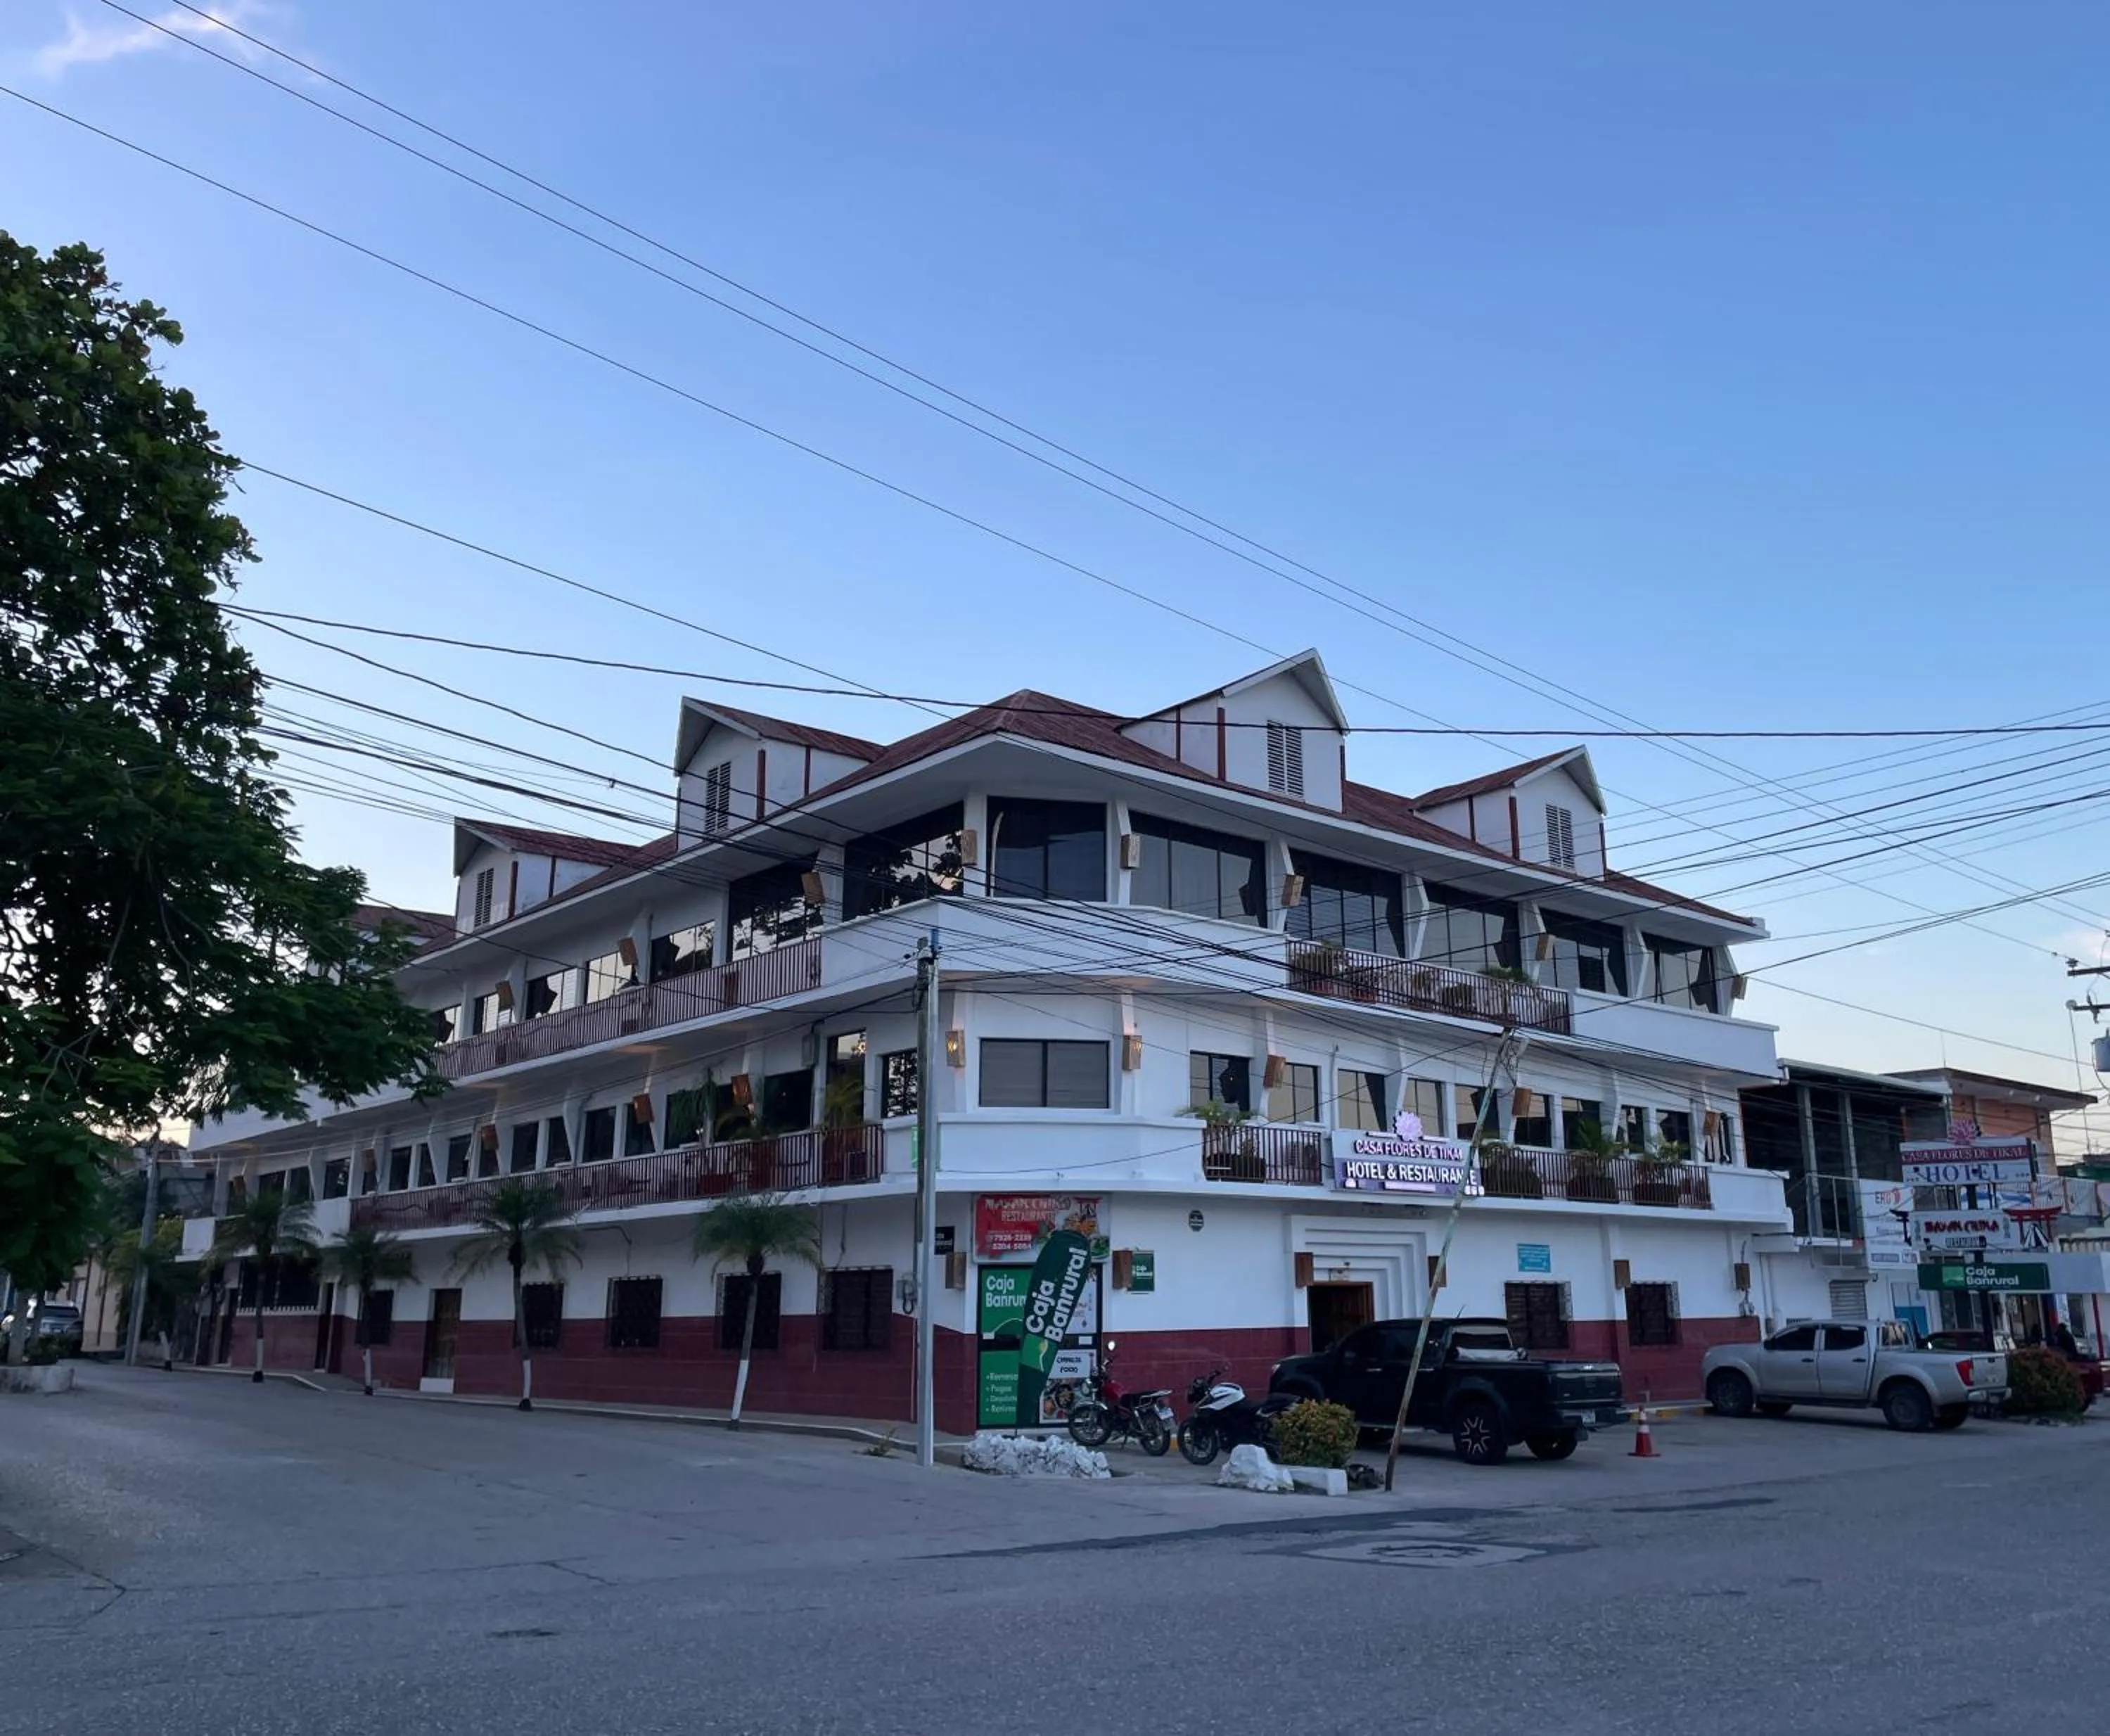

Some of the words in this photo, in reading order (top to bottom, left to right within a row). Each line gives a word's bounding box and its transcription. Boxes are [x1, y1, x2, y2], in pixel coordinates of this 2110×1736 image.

[1355, 1139, 1383, 1154] CASA
[1385, 1141, 1421, 1157] FLORES
[1424, 1144, 1437, 1159] DE
[1346, 1161, 1385, 1179] HOTEL
[1387, 1163, 1397, 1180] &
[1399, 1164, 1478, 1185] RESTAURANE
[1926, 1163, 2007, 1182] HOTEL
[1966, 1267, 1995, 1277] Caja
[1966, 1275, 2019, 1286] Banrural
[987, 1274, 1015, 1294] Caja
[985, 1293, 1027, 1308] Banrur
[1044, 1247, 1088, 1343] Banrural
[1025, 1279, 1055, 1334] Caja
